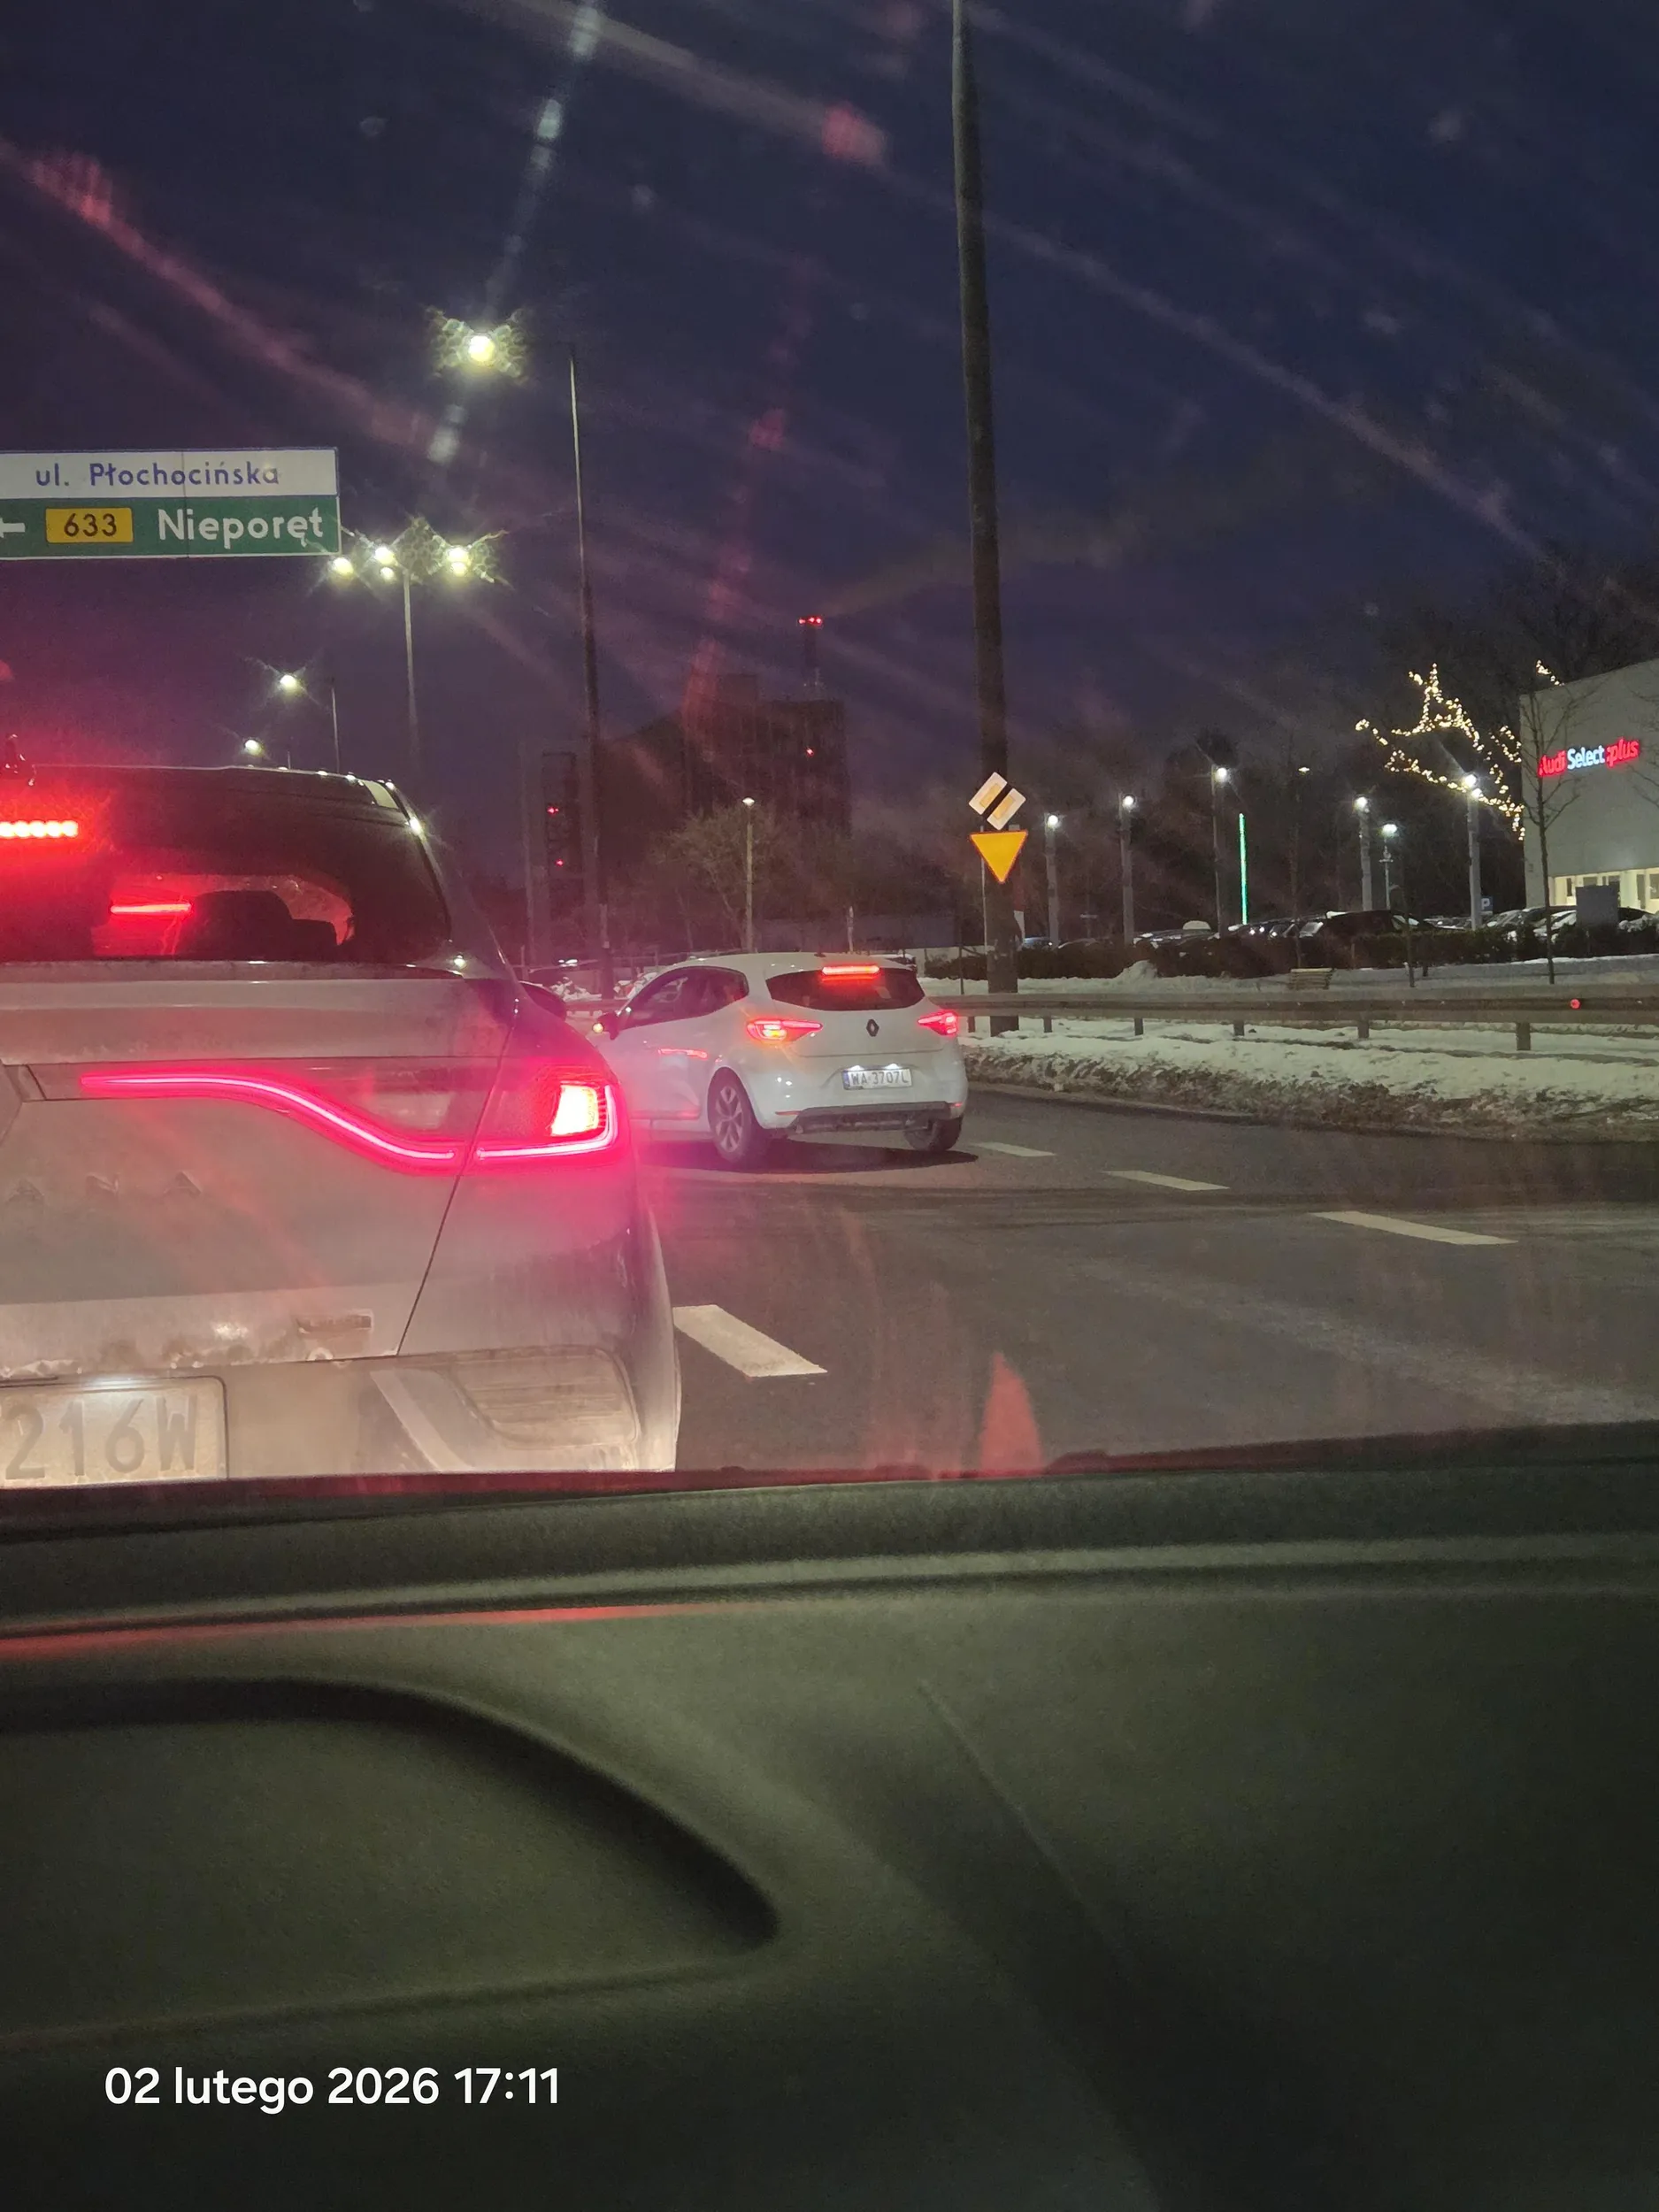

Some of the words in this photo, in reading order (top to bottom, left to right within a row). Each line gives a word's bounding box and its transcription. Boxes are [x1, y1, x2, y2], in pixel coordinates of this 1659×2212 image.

[36, 463, 70, 487] ul.
[89, 461, 280, 487] Płochocińska
[64, 512, 118, 538] 633
[157, 506, 324, 549] Nieporęt
[1567, 745, 1606, 770] Select
[1481, 897, 1491, 910] P
